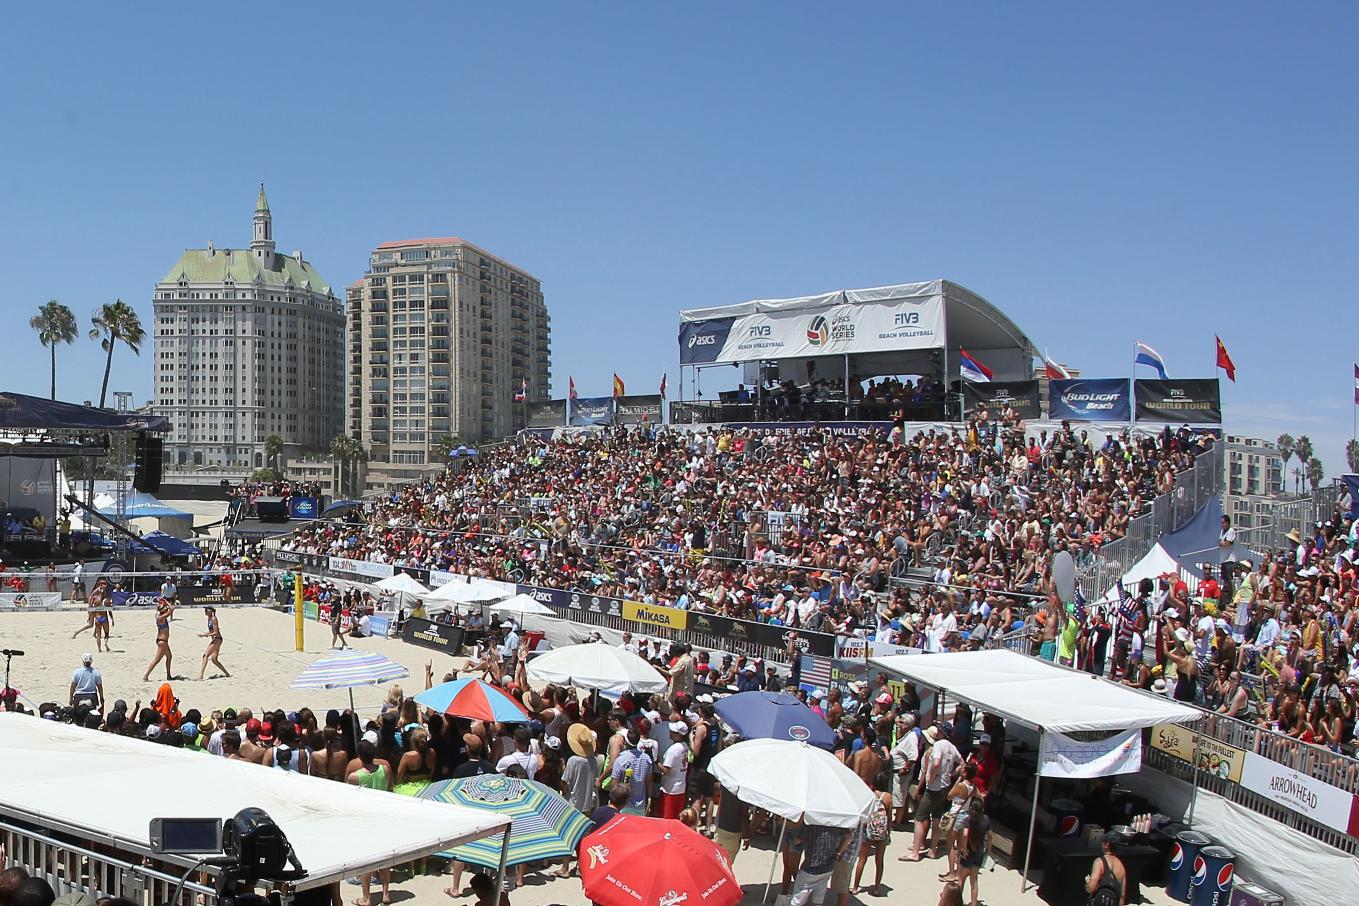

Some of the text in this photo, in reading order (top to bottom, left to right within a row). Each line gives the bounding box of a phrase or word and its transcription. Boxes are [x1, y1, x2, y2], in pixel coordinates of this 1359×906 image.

[894, 312, 920, 325] FIVB
[749, 324, 771, 338] FIVB
[831, 324, 856, 334] WORLD
[696, 334, 716, 346] asics
[831, 331, 856, 340] SERIES
[878, 330, 935, 340] BEACH VOLLEYBALL
[753, 341, 785, 349] VOLLEYBALL
[1067, 392, 1121, 402] BUD LIGHT
[1086, 402, 1114, 411] Beach
[1145, 401, 1211, 411] WORLD TOUR
[137, 593, 164, 605] asic
[535, 592, 552, 603] asics
[635, 608, 671, 625] MIKASA
[413, 631, 433, 642] WORLD
[839, 672, 856, 681] ROSS
[1159, 728, 1181, 749] Sabra
[1211, 743, 1219, 753] THE
[1217, 745, 1236, 759] FULLEST
[1268, 775, 1319, 810] ARROWHEAD
